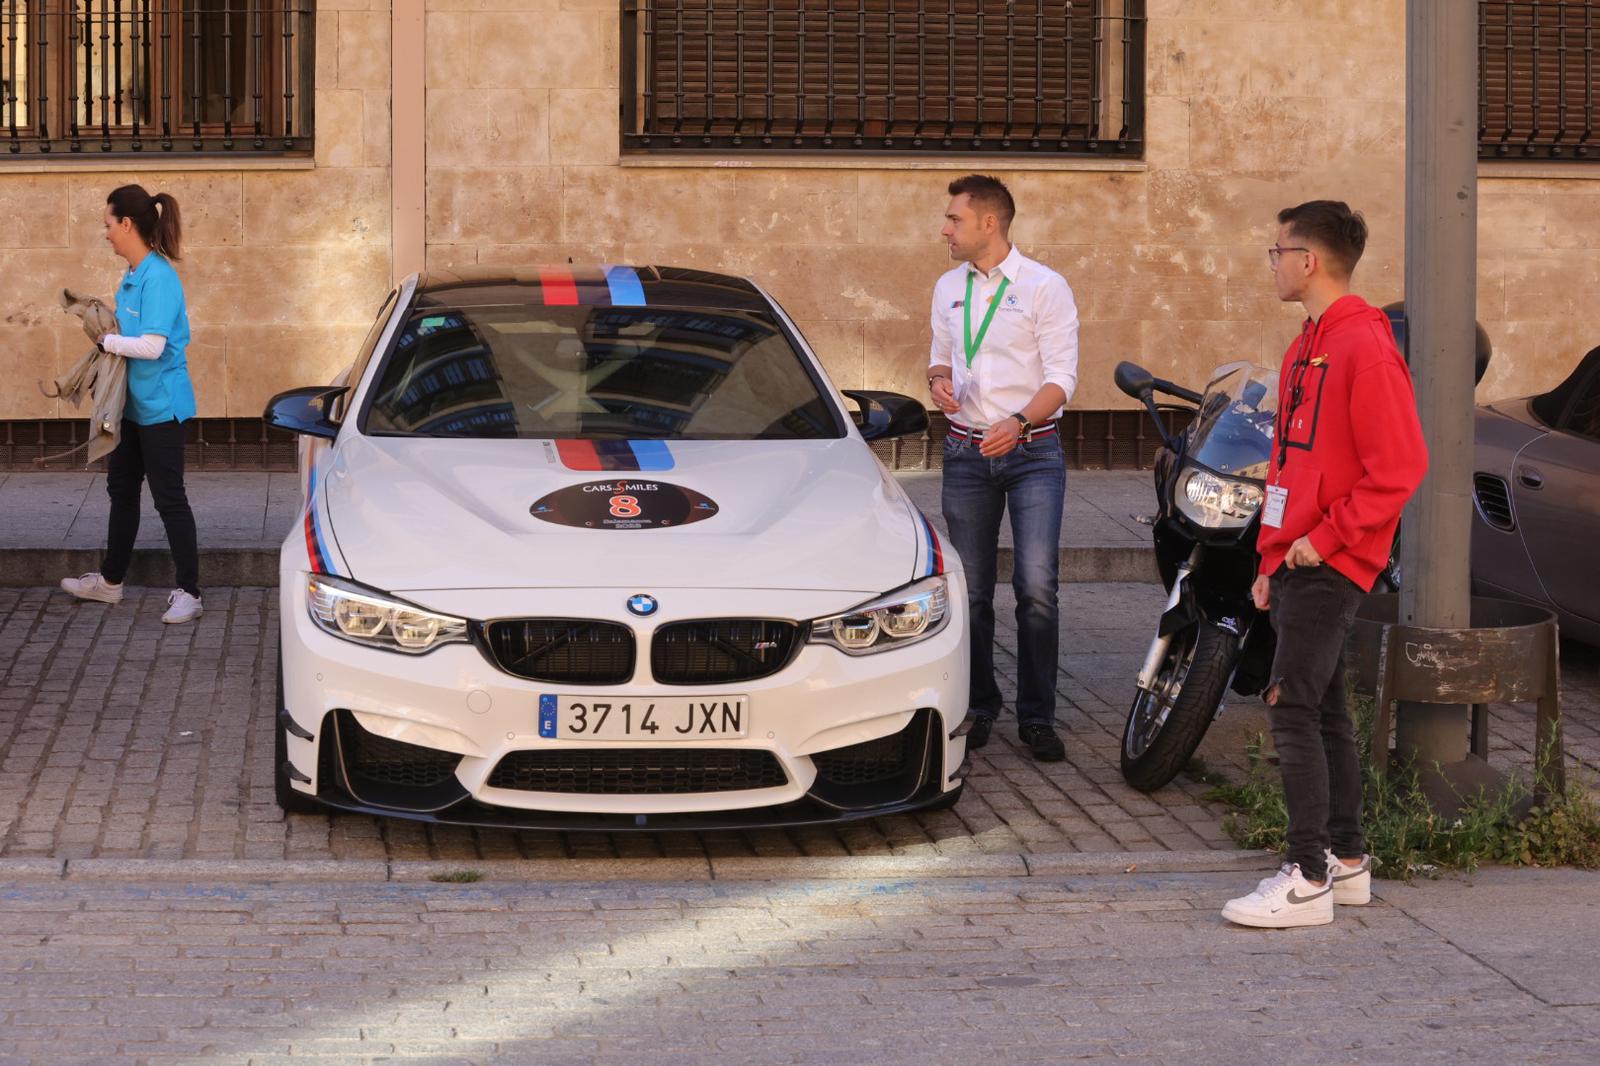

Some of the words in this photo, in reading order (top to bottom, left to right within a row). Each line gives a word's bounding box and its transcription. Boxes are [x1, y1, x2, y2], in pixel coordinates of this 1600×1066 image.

[583, 484, 612, 493] CARS
[609, 495, 641, 517] 8
[544, 720, 552, 730] E
[568, 702, 660, 735] 3714
[674, 701, 742, 734] JXN
